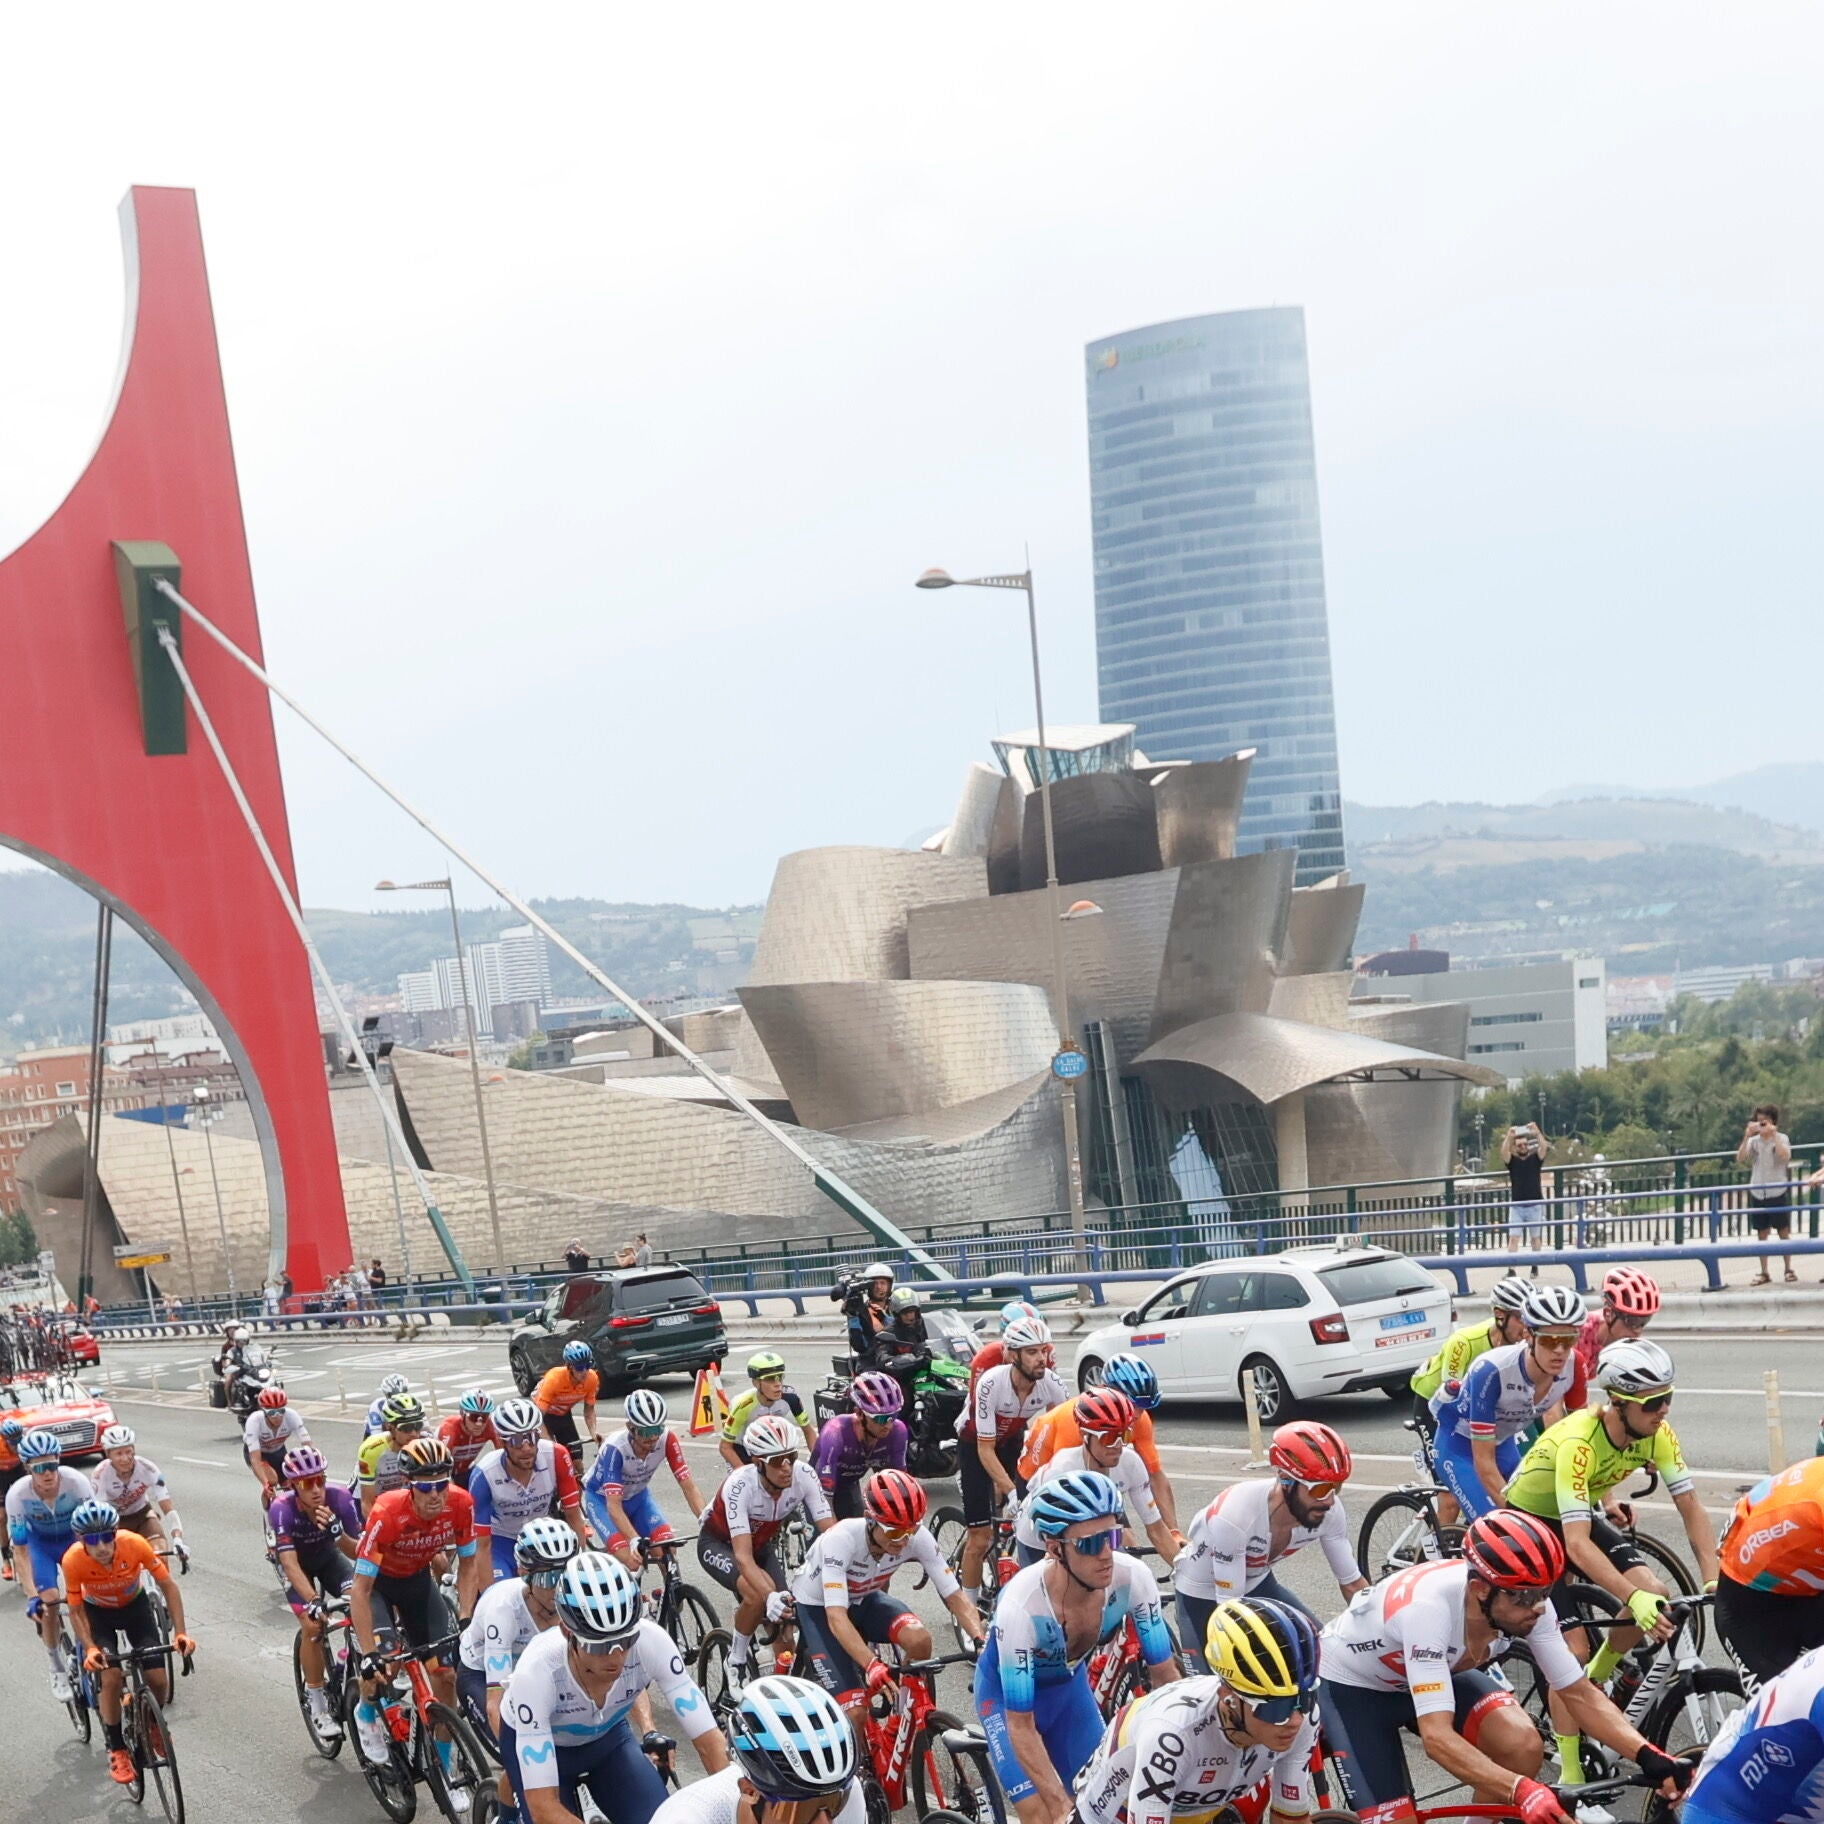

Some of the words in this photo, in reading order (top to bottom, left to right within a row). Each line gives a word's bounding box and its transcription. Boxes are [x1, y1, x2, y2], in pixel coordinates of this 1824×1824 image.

[978, 1378, 995, 1420] Cofidis
[1443, 1459, 1476, 1520] Groupama
[1572, 1445, 1591, 1503] ARKEA
[728, 1479, 746, 1521] Cofidis
[702, 1549, 734, 1574] Cofidis
[1739, 1519, 1800, 1564] ORBEA
[1346, 1638, 1385, 1655] TREK
[1626, 1661, 1671, 1724] ANYON
[885, 1690, 915, 1782] TREK
[1193, 1715, 1216, 1736] BORA
[1088, 1765, 1131, 1816] hansgrohe
[1739, 1754, 1769, 1791] FDJ
